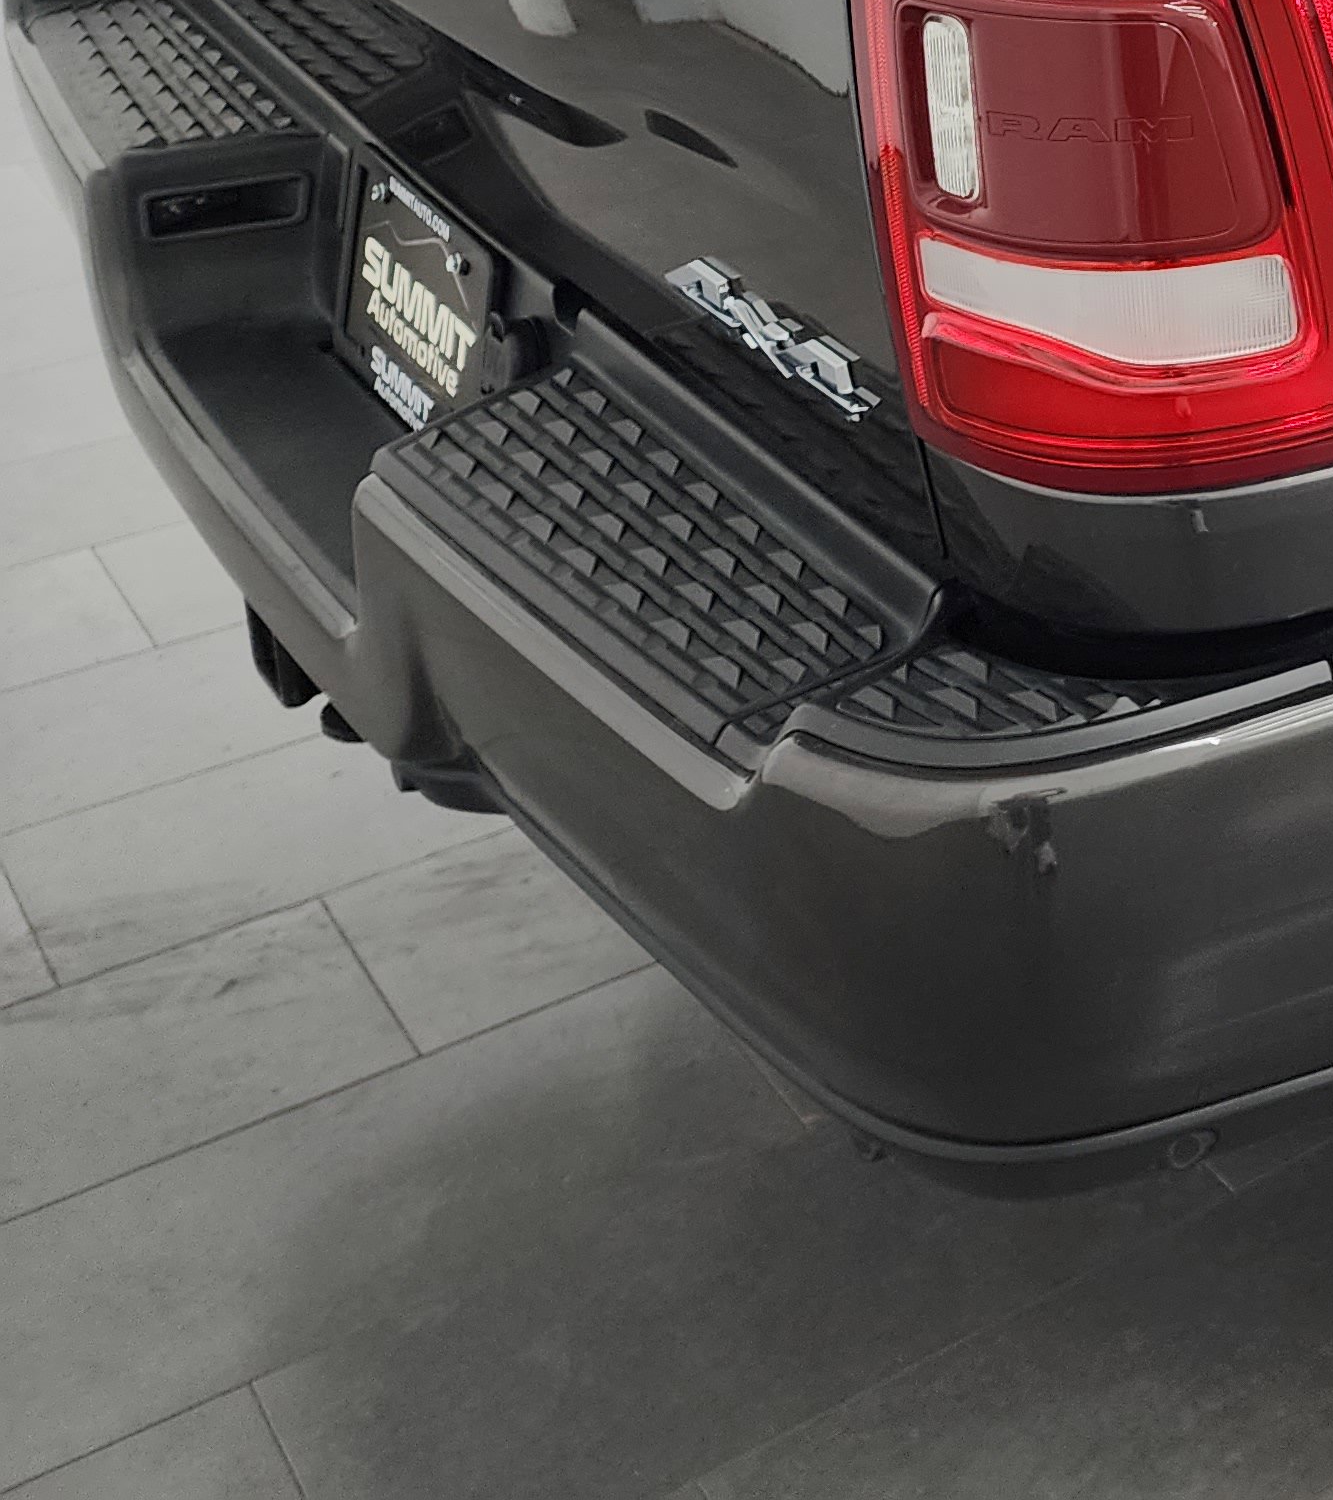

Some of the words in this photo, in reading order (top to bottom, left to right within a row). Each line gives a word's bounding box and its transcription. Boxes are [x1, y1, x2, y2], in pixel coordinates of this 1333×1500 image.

[986, 110, 1195, 143] RAM
[362, 236, 477, 372] SUMMIT
[367, 289, 459, 398] Automotive
[370, 345, 435, 424] SUMMIT
